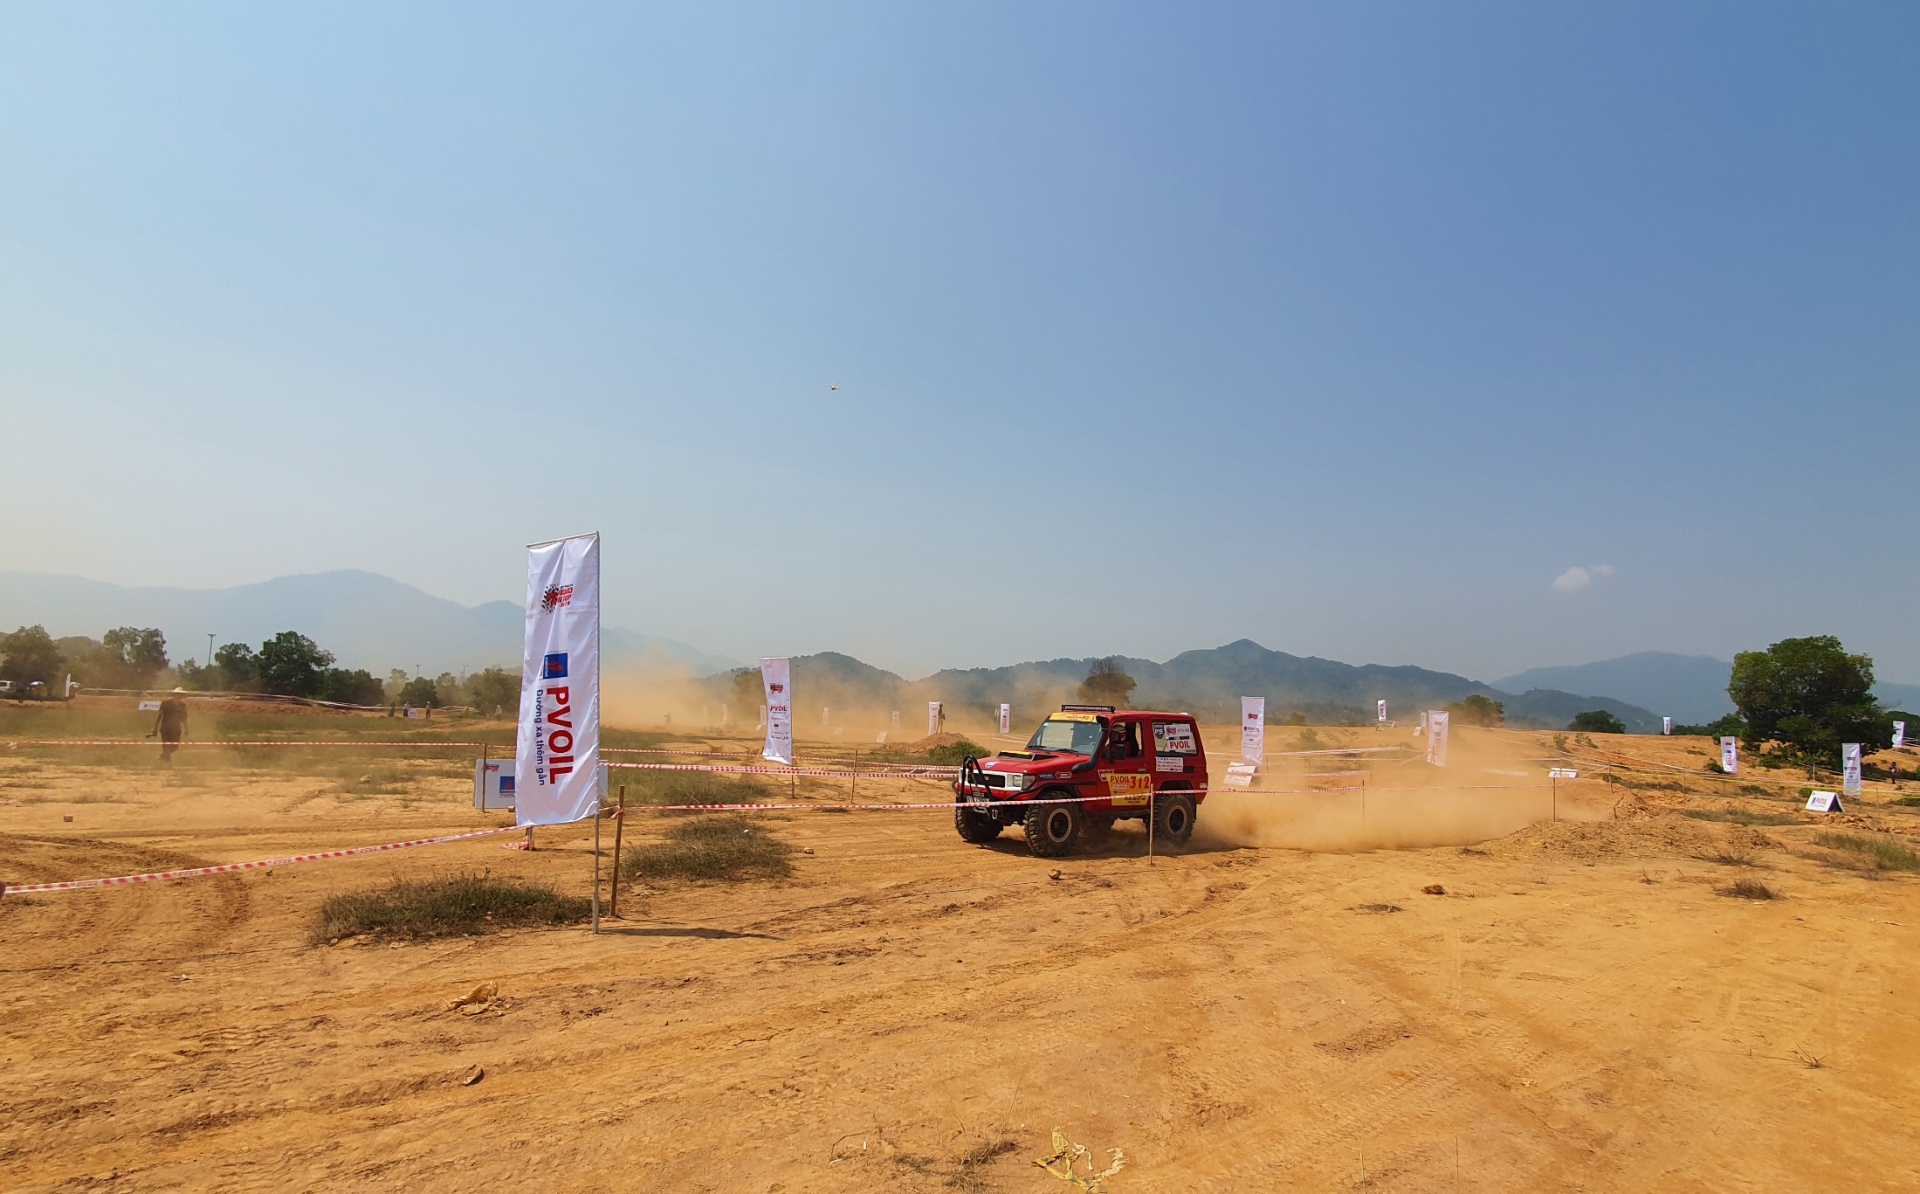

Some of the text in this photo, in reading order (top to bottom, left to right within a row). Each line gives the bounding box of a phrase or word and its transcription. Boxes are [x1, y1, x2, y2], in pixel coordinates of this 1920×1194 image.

[534, 689, 544, 724] Đường
[535, 726, 543, 738] xa
[546, 686, 574, 785] PVOIL
[536, 740, 545, 765] thêm
[1169, 740, 1191, 749] PVOIL
[1110, 775, 1131, 784] PVOIL
[1130, 776, 1150, 789] 312
